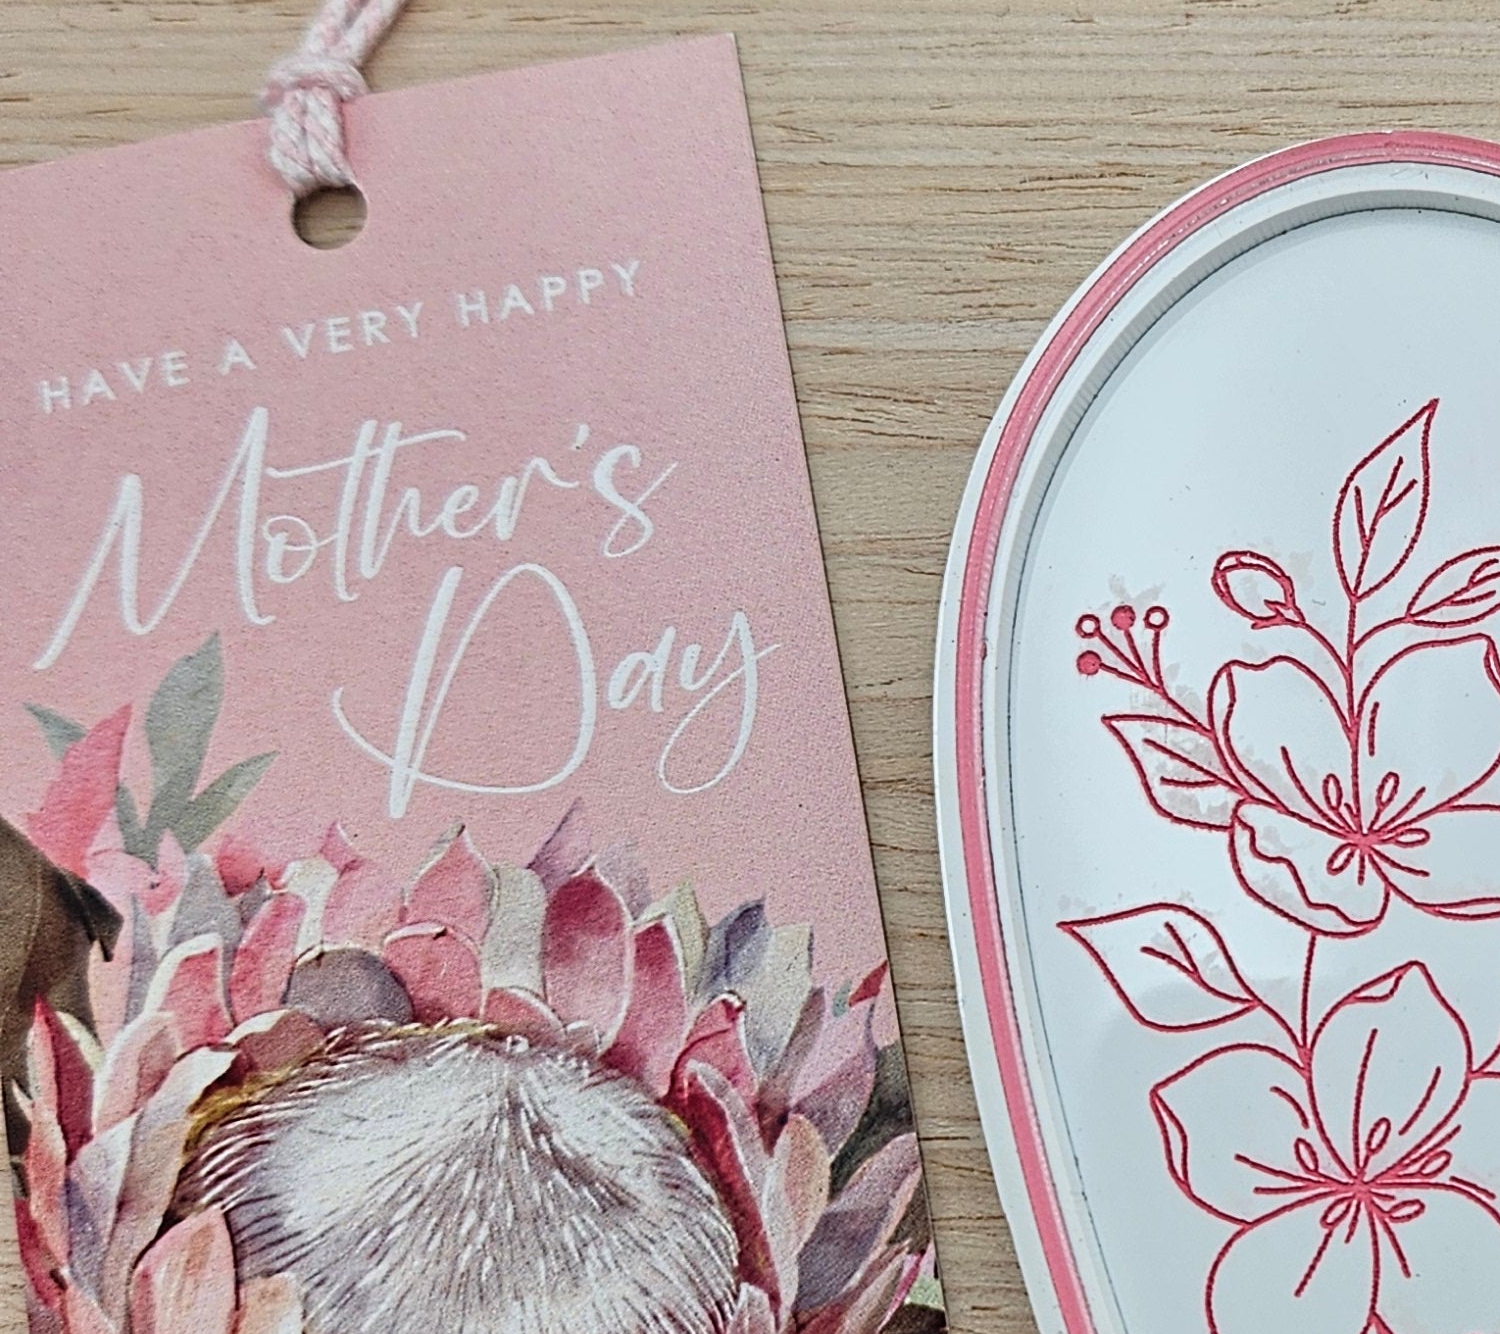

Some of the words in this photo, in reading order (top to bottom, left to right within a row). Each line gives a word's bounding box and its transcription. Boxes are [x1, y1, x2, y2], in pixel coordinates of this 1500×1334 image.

[38, 349, 190, 414] HAVE
[218, 339, 258, 375] A
[279, 302, 427, 360] VERY
[455, 259, 643, 327] HAPPY
[31, 406, 678, 670] Mother's
[331, 562, 782, 820] Day
